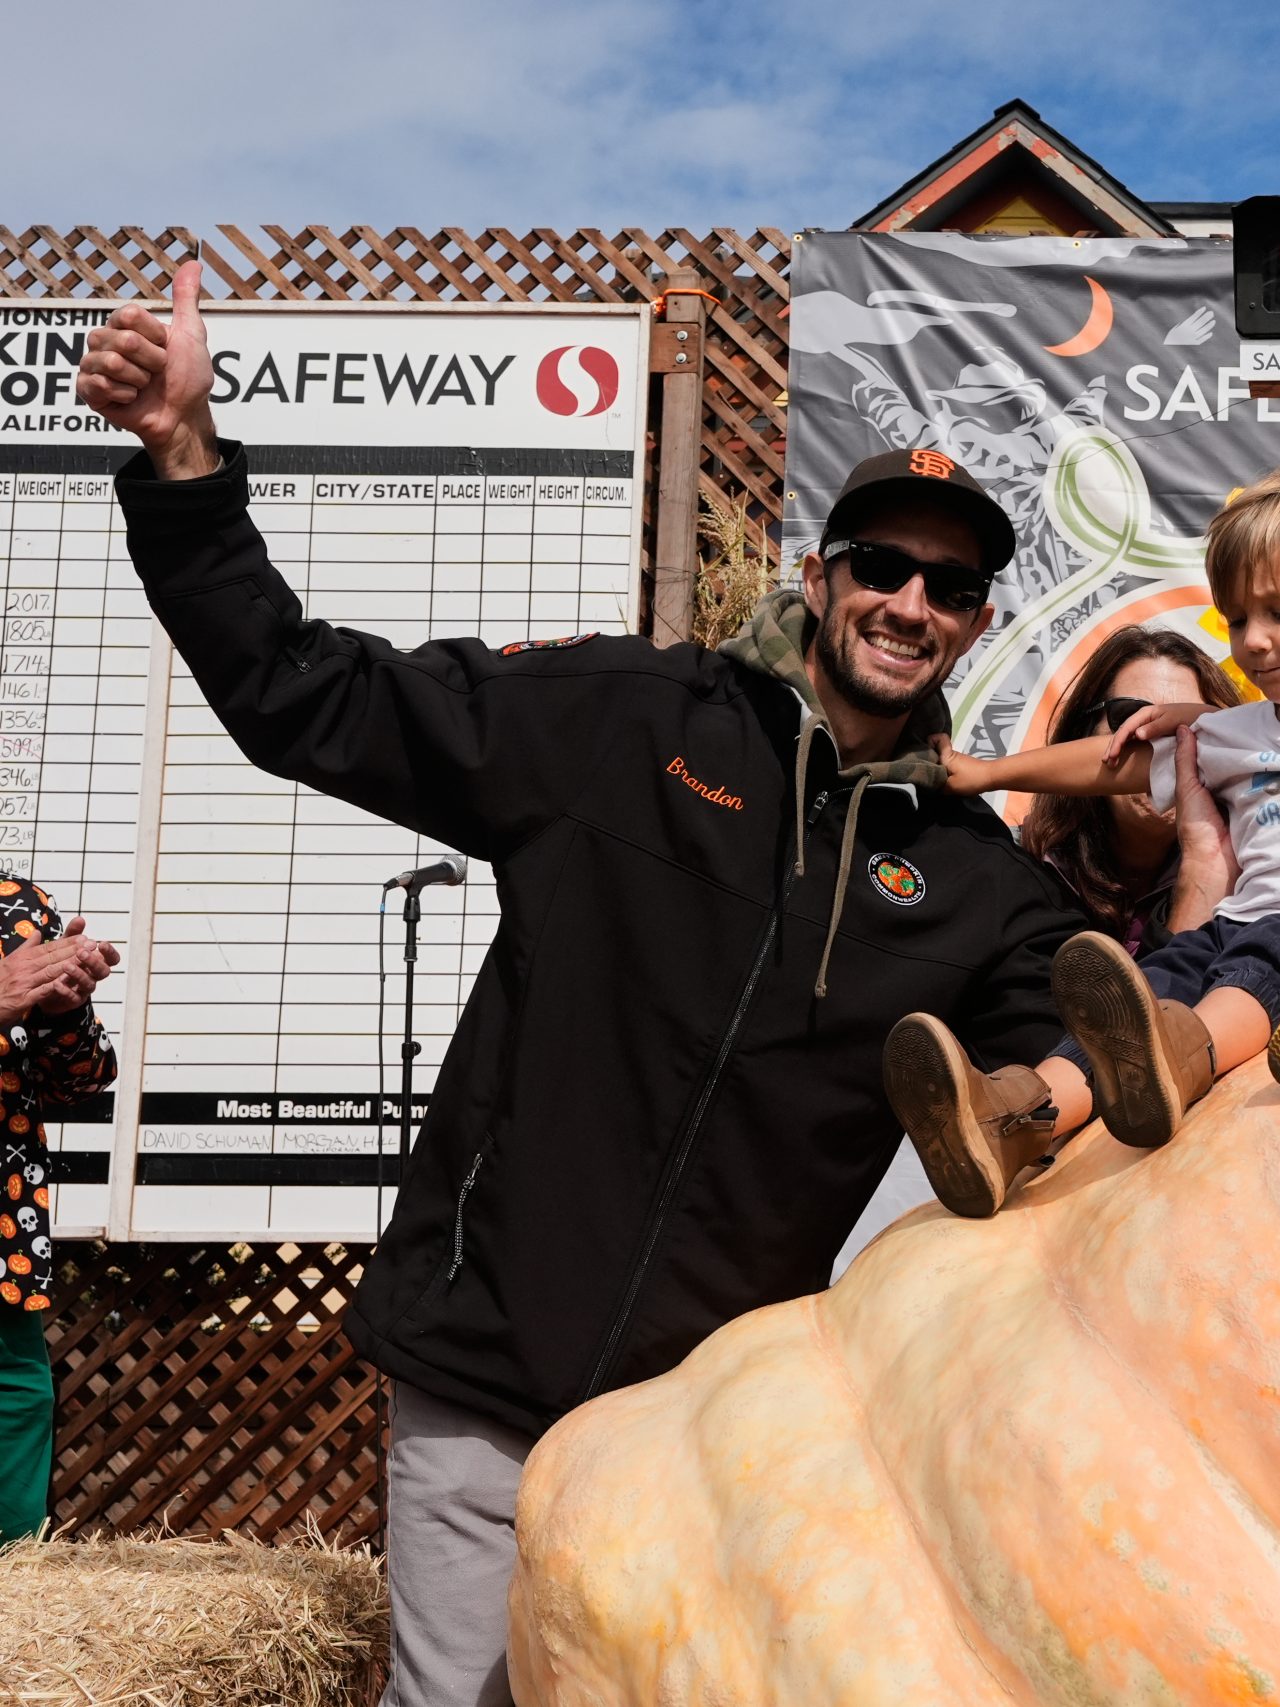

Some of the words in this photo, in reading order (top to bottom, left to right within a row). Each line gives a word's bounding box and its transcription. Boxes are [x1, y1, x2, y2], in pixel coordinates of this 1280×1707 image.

[209, 350, 517, 405] SAFEWAY
[18, 481, 62, 496] WEIGHT
[68, 481, 109, 497] HEIGHT
[316, 483, 434, 500] CITY/STATE
[442, 485, 481, 499] PLACE
[488, 485, 532, 499] WEIGHT
[539, 486, 580, 500] HEIGHT
[586, 486, 627, 501] CIRCUM.
[666, 756, 744, 811] Brandon
[216, 1099, 272, 1119] Most
[278, 1099, 372, 1119] Beautiful
[380, 1100, 428, 1119] Pum
[143, 1129, 190, 1150] DAVID
[195, 1132, 272, 1151] SCHUMAN
[282, 1132, 358, 1150] MORGAN
